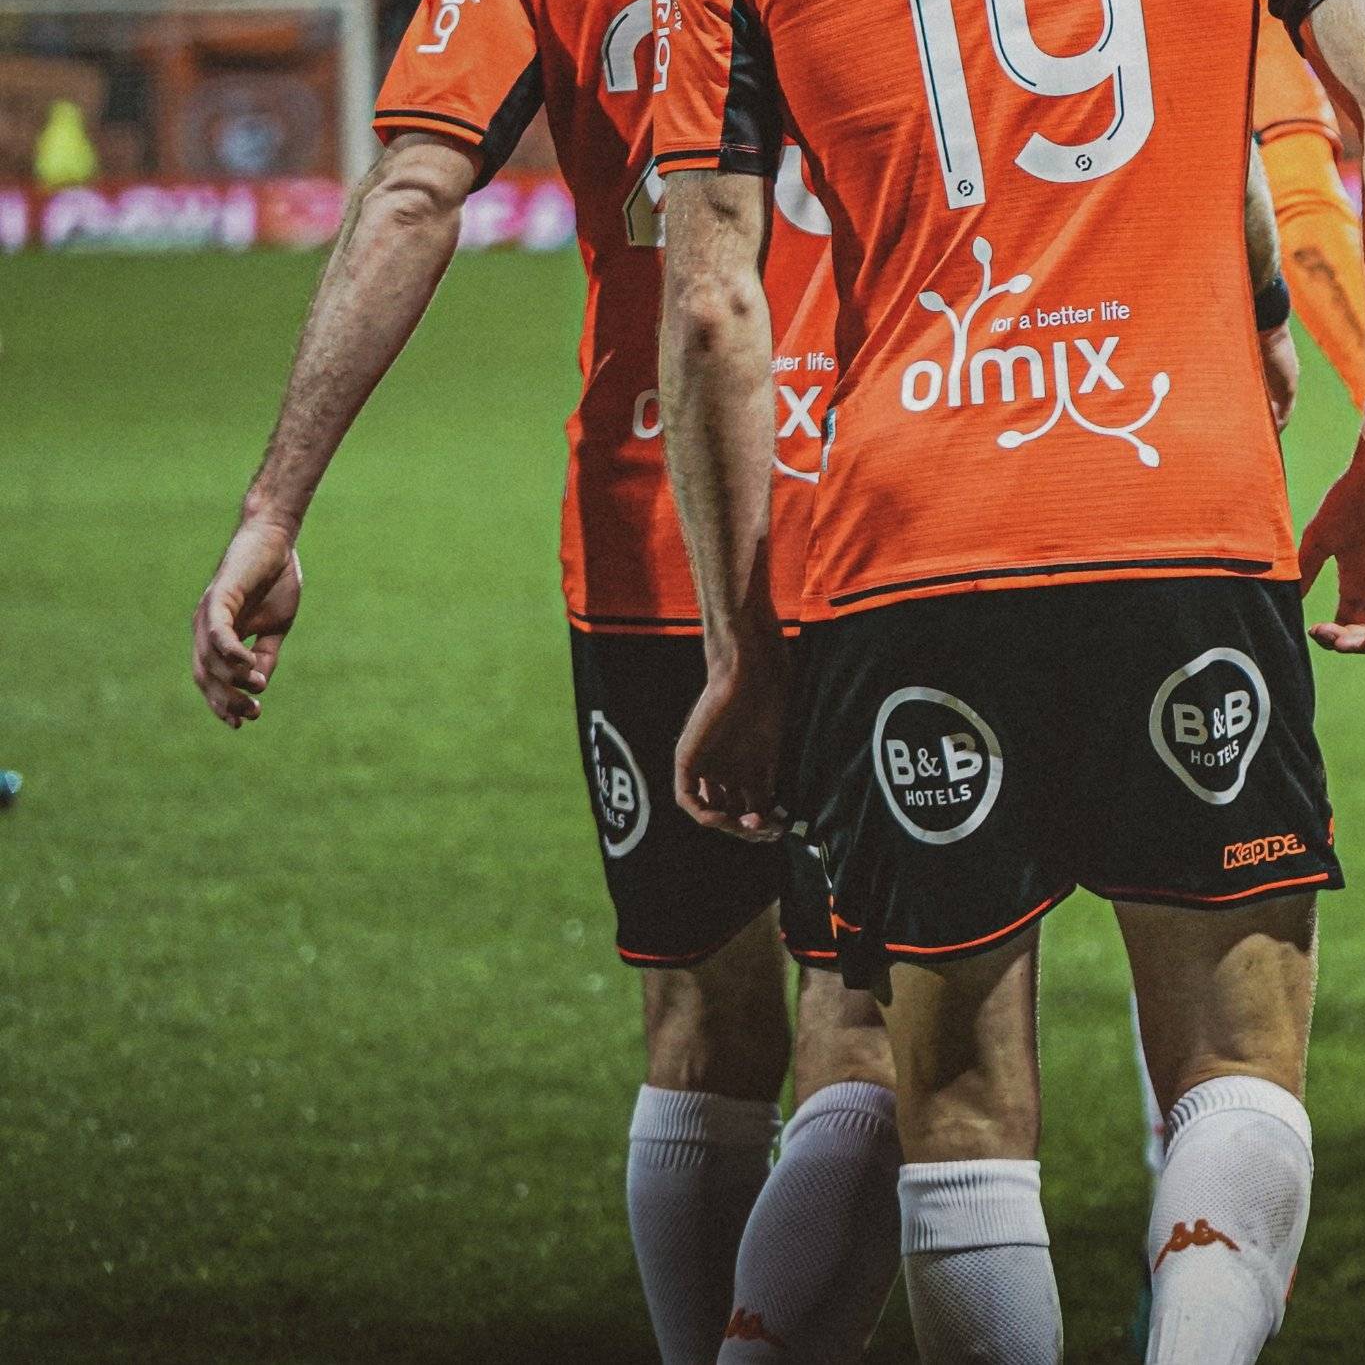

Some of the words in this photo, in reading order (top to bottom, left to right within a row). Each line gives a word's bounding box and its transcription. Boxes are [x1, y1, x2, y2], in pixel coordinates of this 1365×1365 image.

[1020, 315, 1031, 329] a
[1037, 308, 1095, 327] better
[1101, 301, 1130, 320] life
[807, 352, 835, 370] life
[1173, 690, 1252, 745] B&B
[886, 733, 982, 784] B&B
[1190, 739, 1240, 767] HOTELS
[905, 784, 972, 806] HOTELS
[1224, 834, 1306, 869] Kappa
